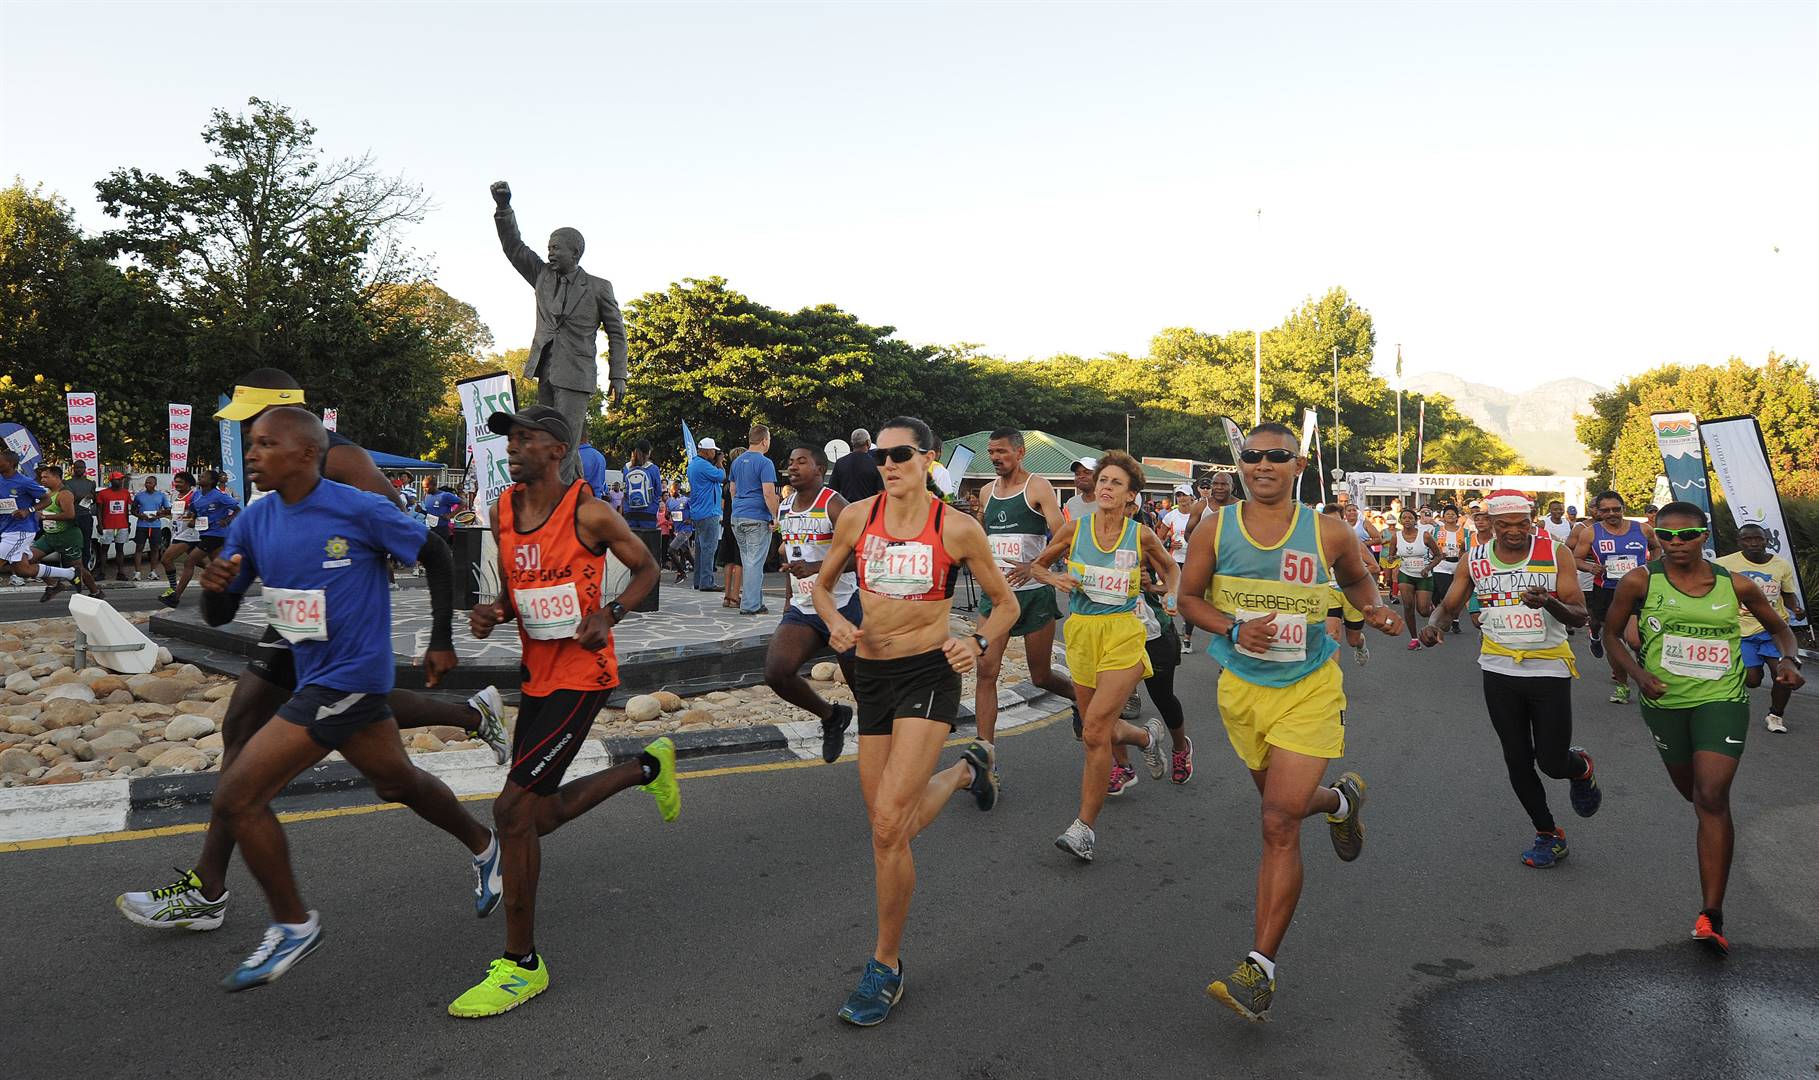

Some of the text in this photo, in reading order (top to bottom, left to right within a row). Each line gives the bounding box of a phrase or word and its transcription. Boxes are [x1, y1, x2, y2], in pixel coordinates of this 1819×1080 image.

[1419, 477, 1449, 486] START
[1459, 478, 1494, 487] BEGIN
[513, 543, 539, 570] 50
[996, 542, 1020, 555] 1749
[1600, 541, 1614, 552] 50
[887, 553, 929, 575] 1713
[1283, 553, 1314, 584] 50
[1471, 559, 1491, 580] 60
[1098, 575, 1129, 593] 1241
[1510, 572, 1553, 592] PAARL
[277, 599, 320, 623] 1784
[530, 594, 574, 619] 1839
[1221, 589, 1308, 614] TYGERBERG
[1505, 613, 1543, 629] 1205
[1268, 622, 1304, 644] 240
[1686, 644, 1730, 664] 1852
[530, 733, 573, 777] new balance
